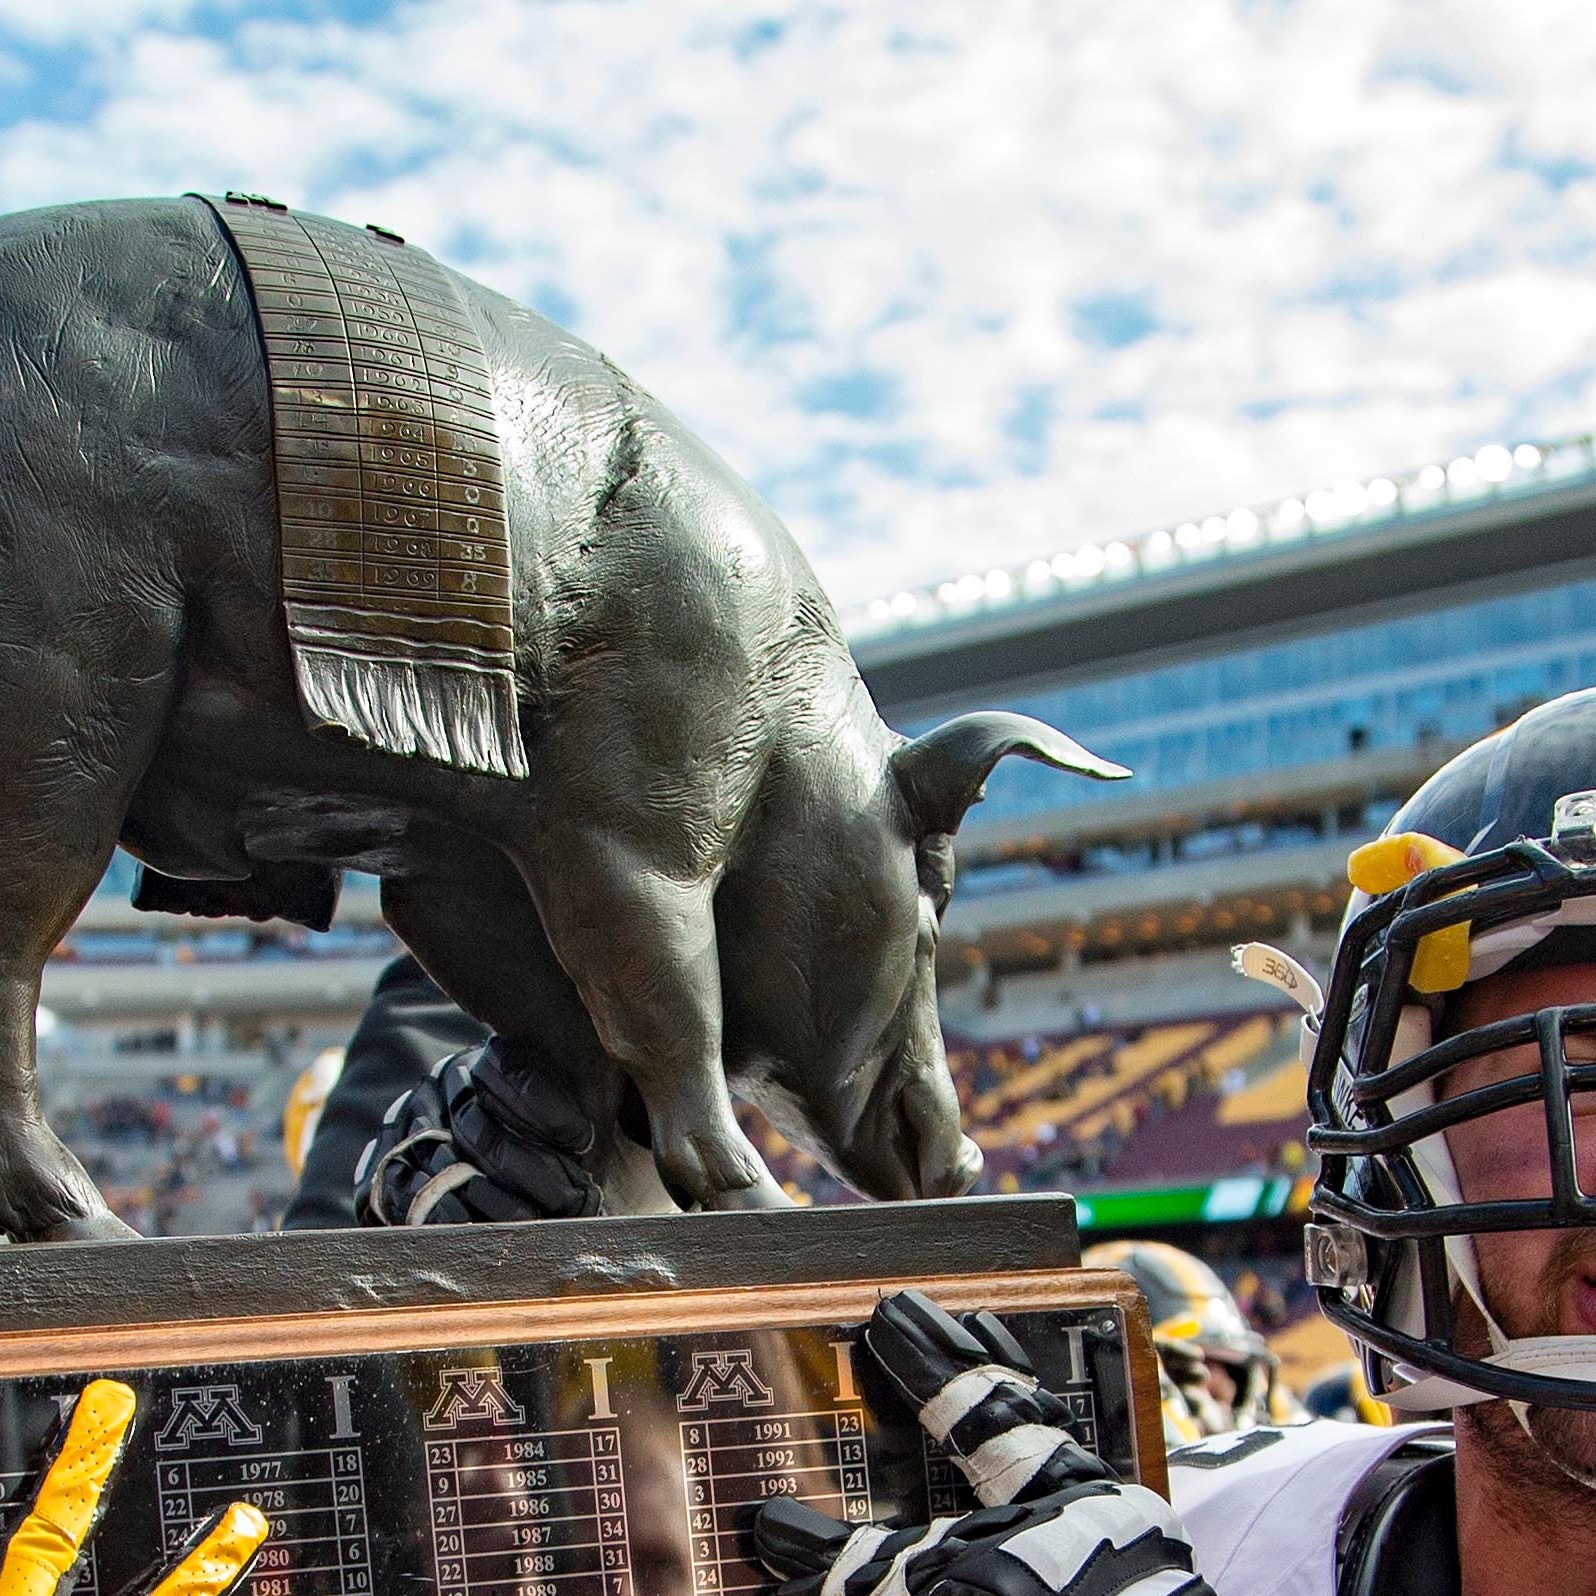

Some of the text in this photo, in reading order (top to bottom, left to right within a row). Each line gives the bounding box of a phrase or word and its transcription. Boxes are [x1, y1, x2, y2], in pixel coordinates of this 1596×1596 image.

[360, 347, 416, 367] 1961
[363, 369, 426, 391] 1962
[365, 393, 425, 415] 1963
[368, 420, 425, 442] 1964
[370, 446, 429, 466] 1965
[372, 474, 432, 497] 1966
[373, 505, 431, 529] 1967
[373, 534, 434, 558] 1968
[373, 567, 435, 586] 1969
[1060, 1326, 1093, 1384] I
[828, 1341, 862, 1402] I
[583, 1356, 618, 1420] I
[325, 1375, 362, 1440] I
[1076, 1398, 1086, 1415] 7
[689, 1416, 859, 1445] 8 1991 23
[430, 1434, 616, 1465] 23 1984 17
[687, 1443, 862, 1475] 28 1992 13
[167, 1454, 358, 1486] 6 1977 18
[438, 1463, 619, 1494] 9 1985 31
[931, 1466, 948, 1482] 27
[694, 1471, 865, 1503] 3 1993 21
[165, 1499, 187, 1517] 22
[338, 1484, 360, 1503] 20
[436, 1491, 621, 1524] 27 1986 30
[346, 1514, 357, 1532] 7
[692, 1499, 868, 1531] 42 49
[438, 1520, 624, 1553] 20 1987 34
[259, 1542, 360, 1569] 980 6
[699, 1541, 710, 1558] 3
[441, 1549, 626, 1582] 22 1988 31
[697, 1568, 718, 1586] 24
[346, 1572, 367, 1590] 10
[613, 1577, 624, 1595] 7
